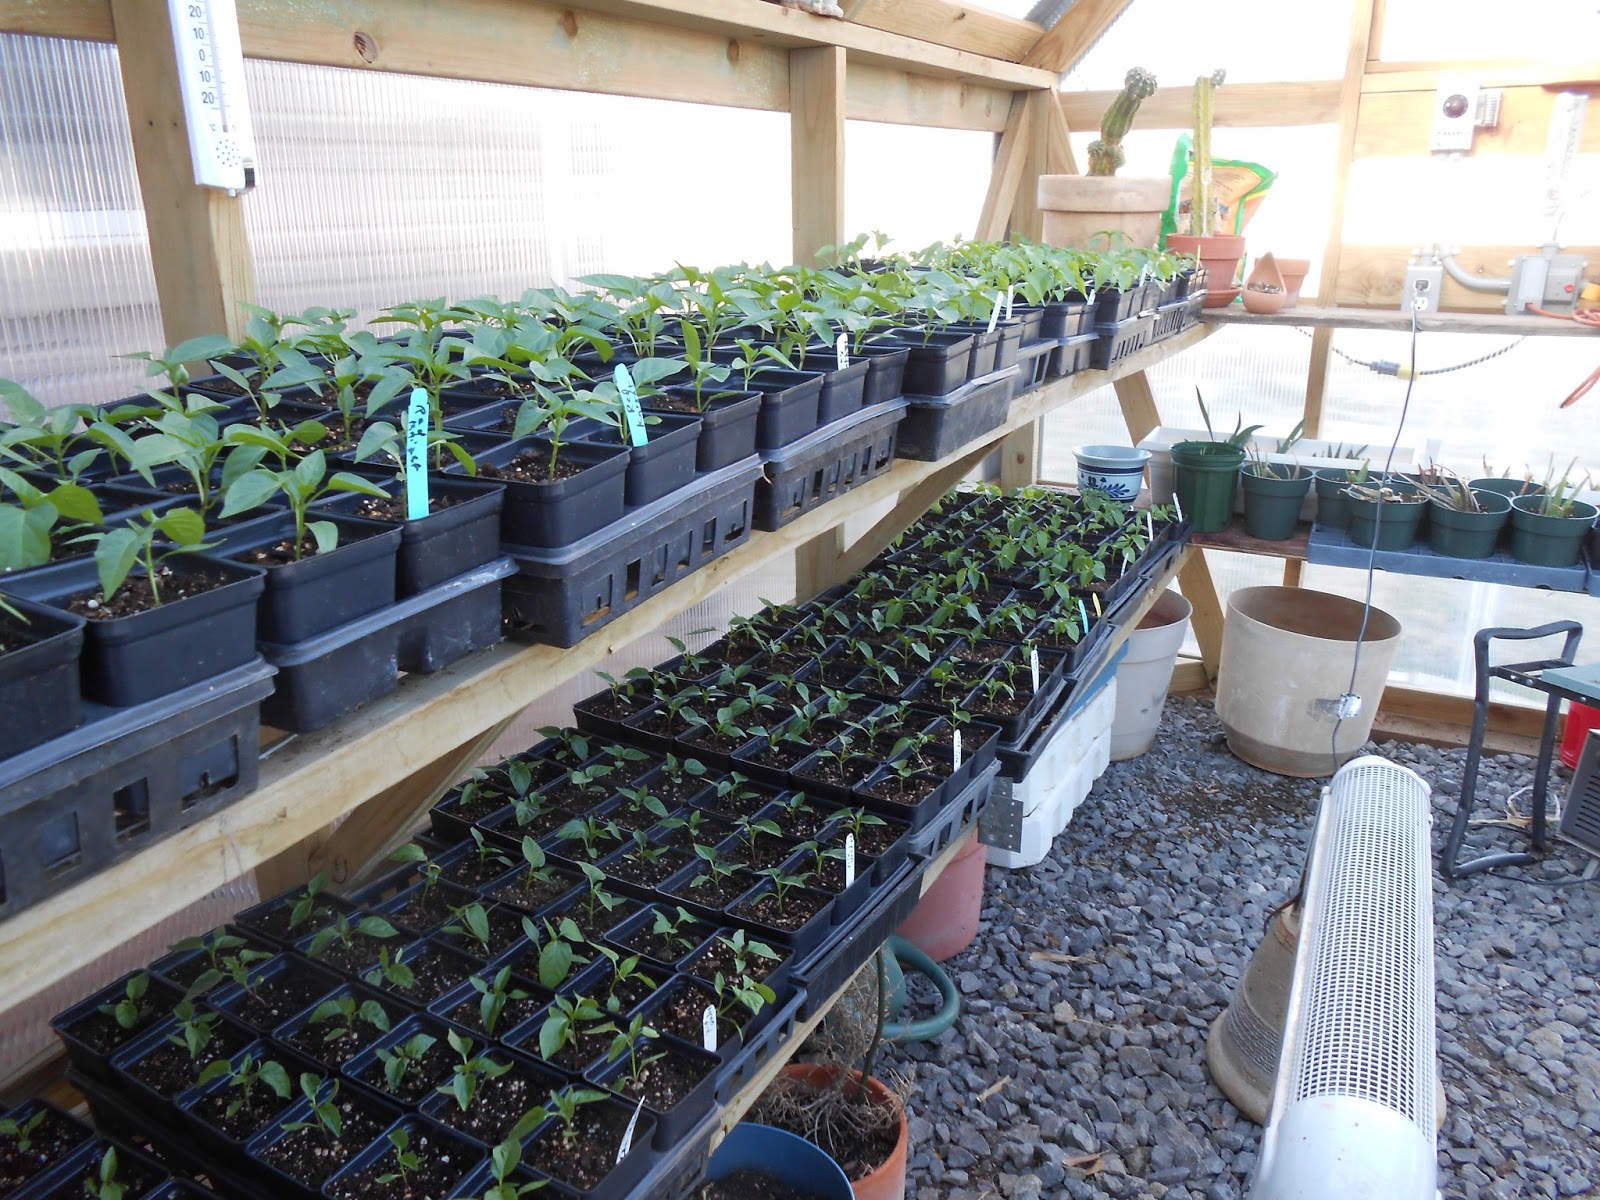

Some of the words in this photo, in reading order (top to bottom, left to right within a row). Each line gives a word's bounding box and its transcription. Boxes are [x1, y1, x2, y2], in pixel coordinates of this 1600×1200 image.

[189, 5, 202, 18] 20
[192, 27, 205, 40] 10
[198, 49, 206, 62] 0
[199, 70, 211, 83] 10
[202, 91, 215, 104] 20
